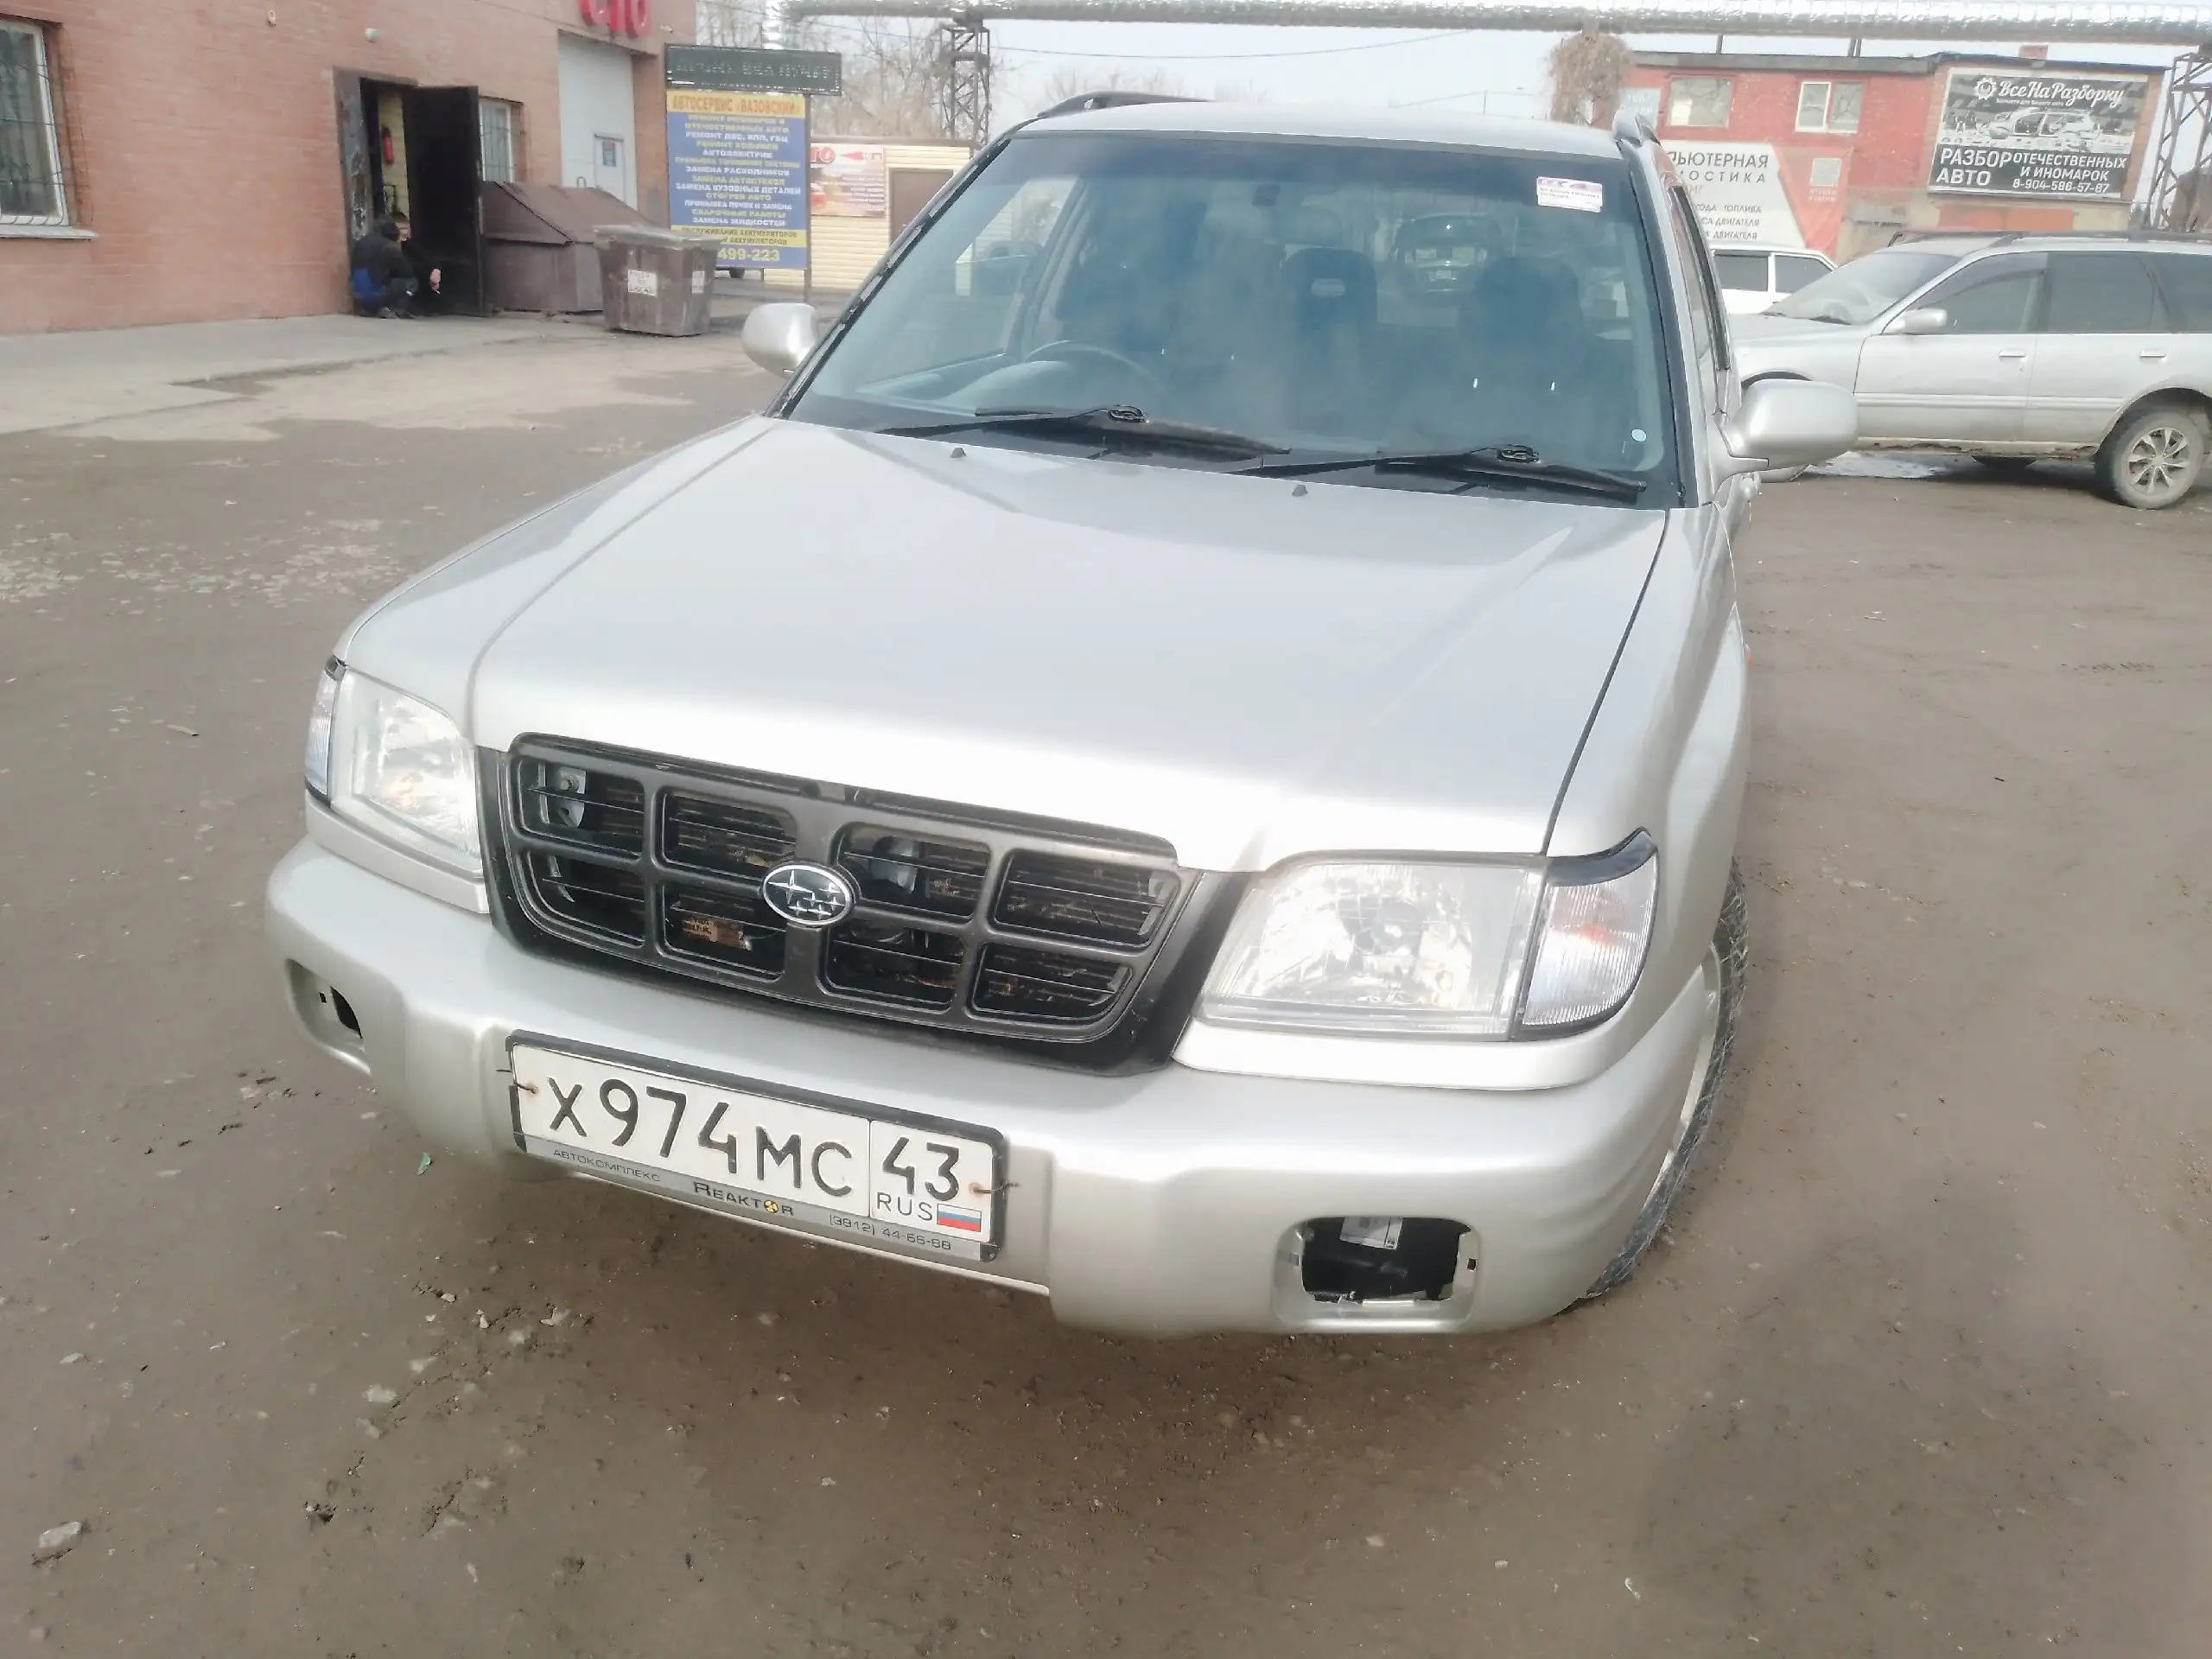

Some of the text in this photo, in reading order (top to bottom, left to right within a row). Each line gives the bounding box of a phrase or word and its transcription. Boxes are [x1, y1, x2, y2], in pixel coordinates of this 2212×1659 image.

[673, 96, 733, 111] АВТОСЕРВИС
[1936, 147, 2013, 187] РАЗБОР АВТО
[2013, 152, 2127, 169] ОТЕЧЕСТВЕННЫХ
[2019, 166, 2110, 181] И ИНОМАРОК
[1714, 217, 1759, 227] ДВИГАТЕЛЯ
[1713, 231, 1758, 240] ДВИГАТЕЛЯ
[553, 1148, 661, 1182] АВТОКОМПЛЕКС
[882, 1136, 959, 1202] 43
[876, 1192, 933, 1222] RUS
[830, 1213, 951, 1250] (3812) 44-66-88
